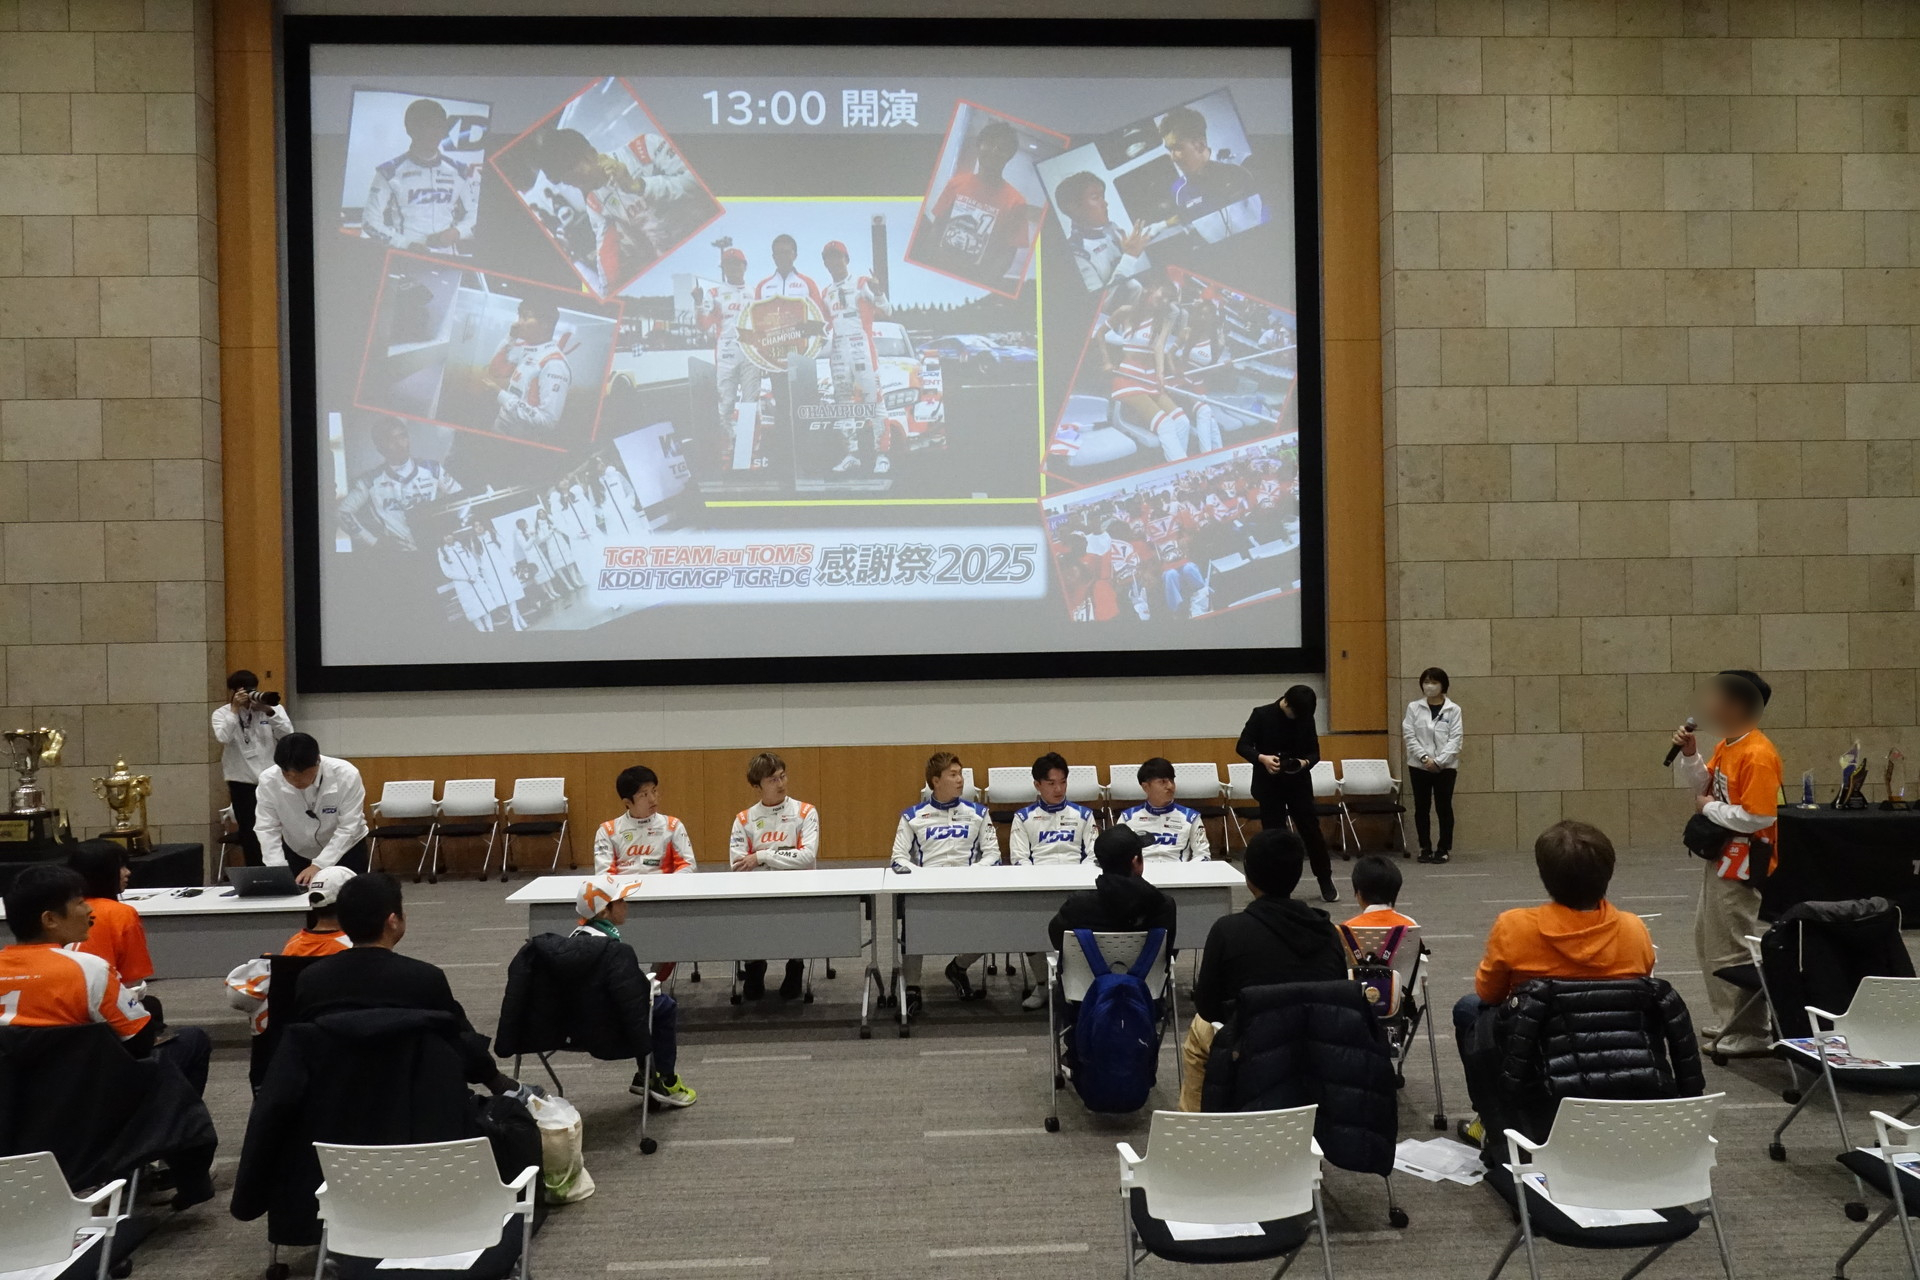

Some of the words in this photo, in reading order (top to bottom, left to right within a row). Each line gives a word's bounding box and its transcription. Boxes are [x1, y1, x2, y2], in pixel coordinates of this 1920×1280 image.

[702, 90, 826, 126] 13:00
[841, 88, 919, 128] 開演
[761, 330, 802, 347] CHAMPION
[798, 403, 877, 419] CHAMPION
[809, 421, 831, 431] GT
[605, 548, 648, 567] TGR
[650, 546, 714, 566] TEAM
[715, 549, 744, 565] au
[747, 544, 813, 565] TOM'S
[599, 569, 651, 590] KDDI
[656, 568, 730, 588] TGMGP
[733, 567, 811, 587] TGR-DC
[761, 831, 788, 843] au
[926, 825, 970, 840] KDDI
[1038, 829, 1076, 843] KDDI
[1149, 832, 1179, 846] DDI
[625, 843, 655, 857] au
